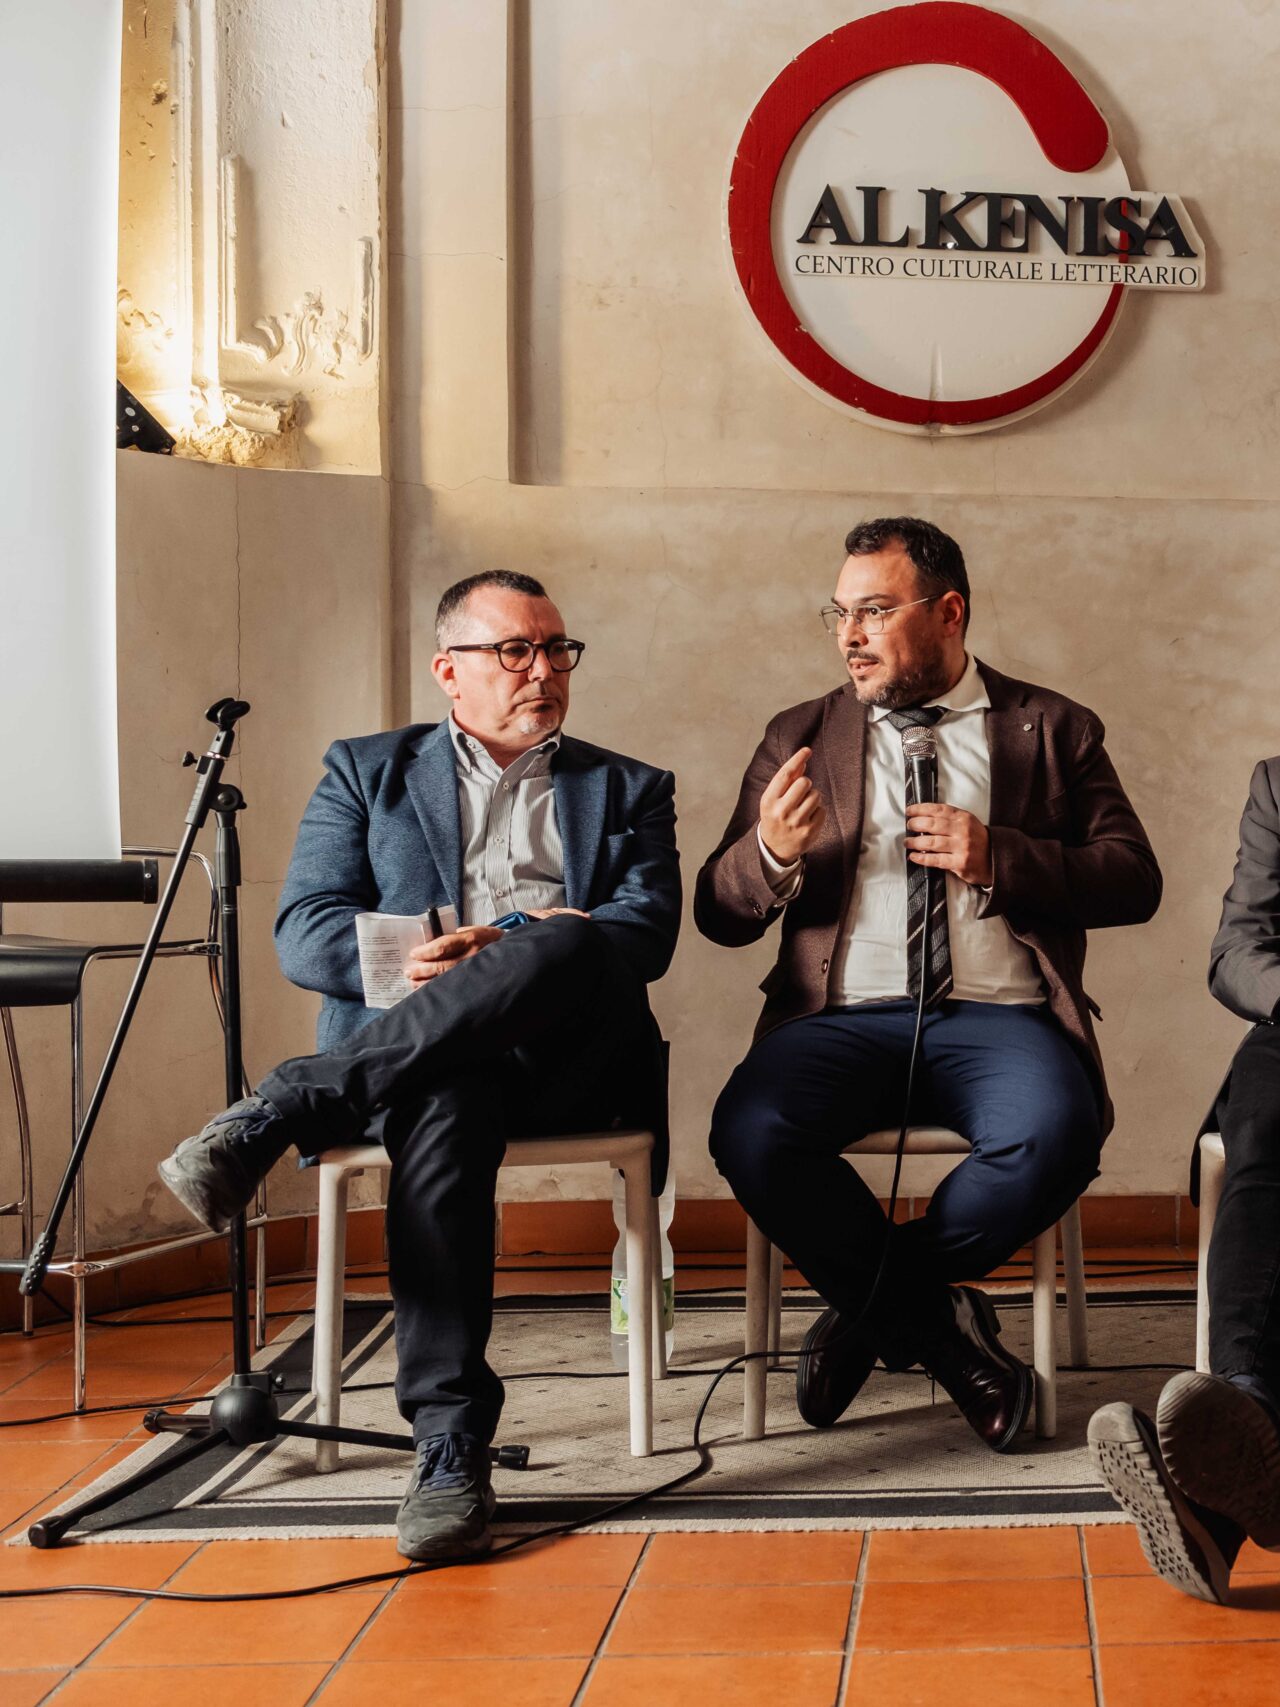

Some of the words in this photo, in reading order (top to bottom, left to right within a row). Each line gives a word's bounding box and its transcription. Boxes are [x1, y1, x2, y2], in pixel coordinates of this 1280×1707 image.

[795, 255, 895, 276] CENTRO
[903, 258, 1042, 280] CULTURALE
[1050, 261, 1197, 286] LETTERARIO
